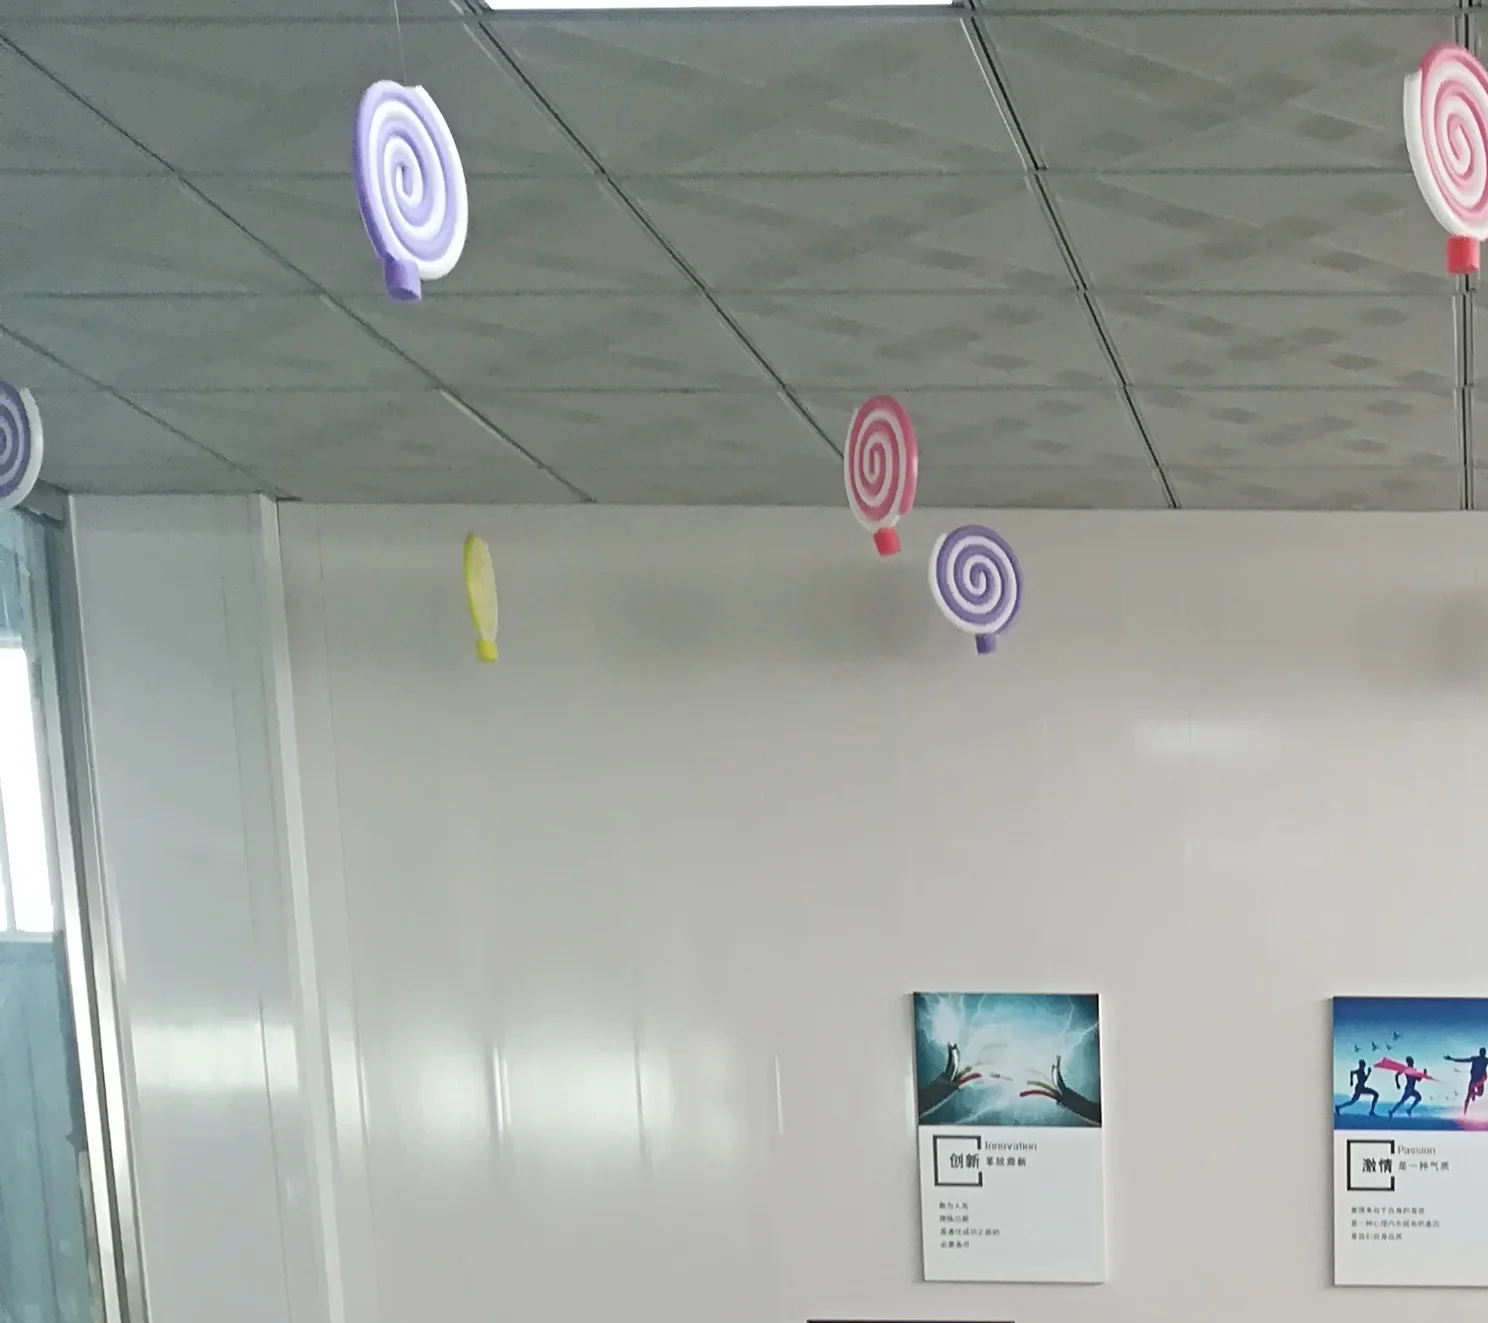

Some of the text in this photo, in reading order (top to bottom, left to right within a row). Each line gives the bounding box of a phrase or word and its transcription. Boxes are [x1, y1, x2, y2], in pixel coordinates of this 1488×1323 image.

[985, 1140, 1037, 1151] Innovation
[1398, 1145, 1436, 1155] Passion
[949, 1152, 980, 1169] 创新
[1362, 1157, 1393, 1173] 激情
[1398, 1160, 1450, 1172] 是一种气质
